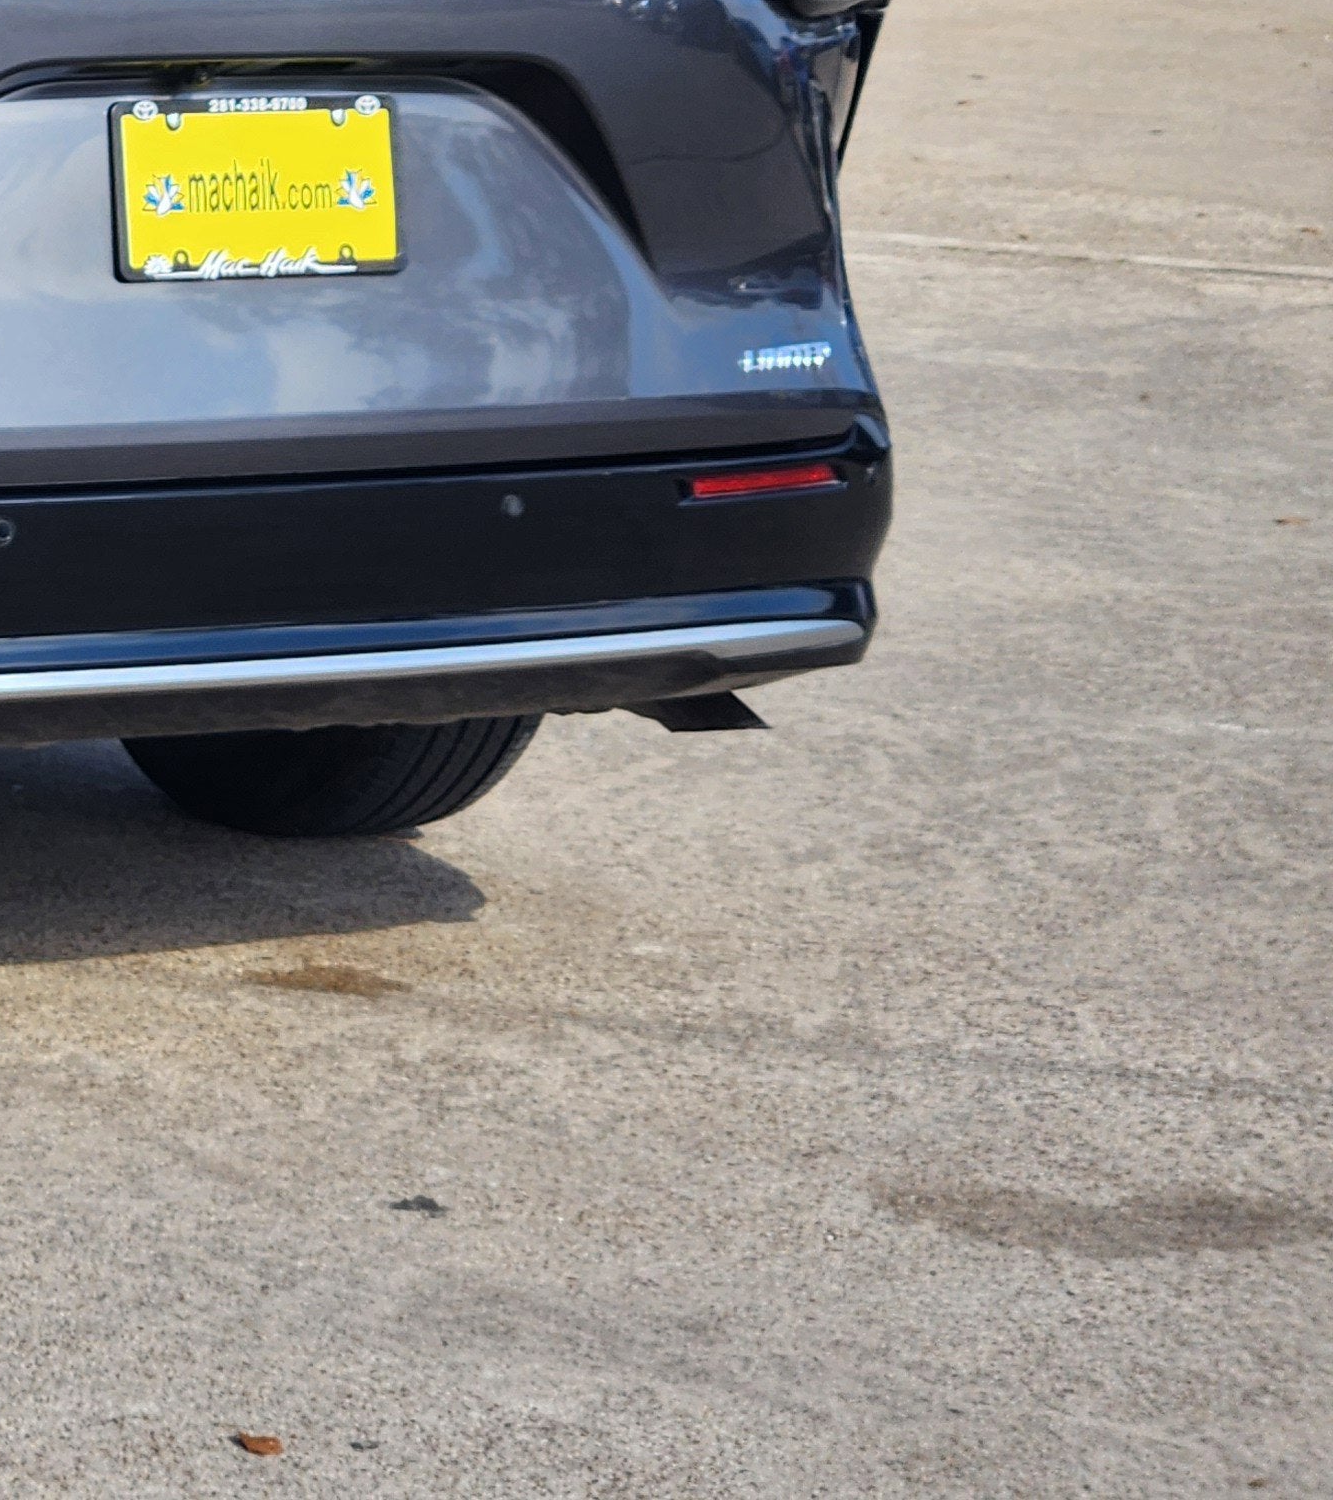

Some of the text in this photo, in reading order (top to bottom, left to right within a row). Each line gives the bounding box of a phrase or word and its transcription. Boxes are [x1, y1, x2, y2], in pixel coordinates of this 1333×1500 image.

[188, 158, 333, 212] machaik.com
[199, 247, 320, 280] Mac Haik
